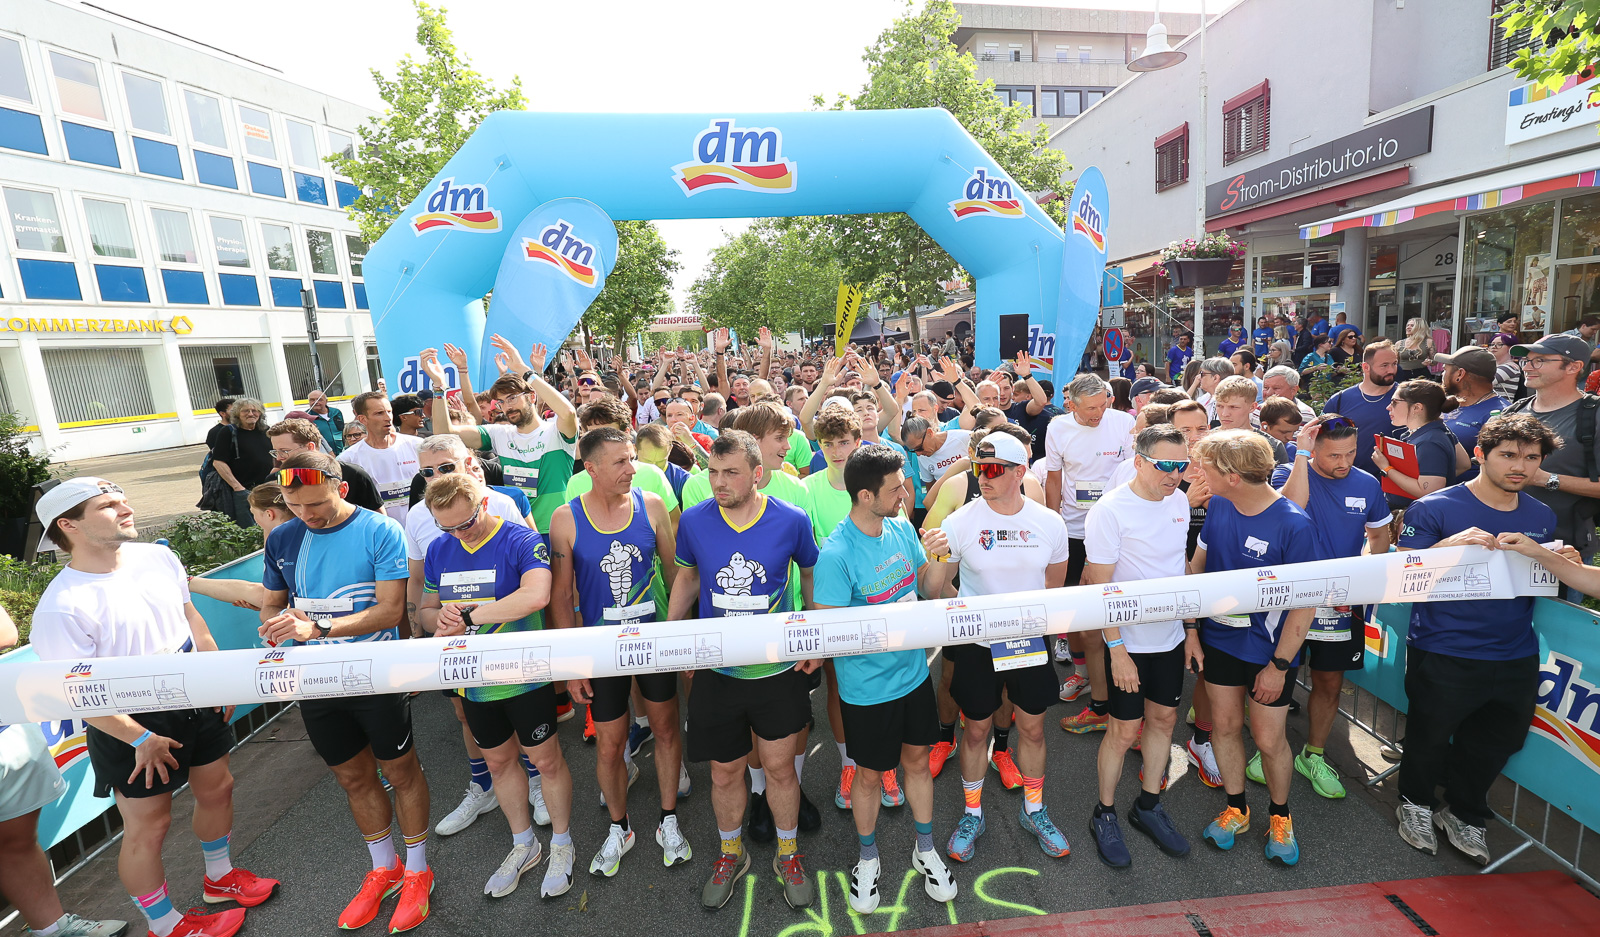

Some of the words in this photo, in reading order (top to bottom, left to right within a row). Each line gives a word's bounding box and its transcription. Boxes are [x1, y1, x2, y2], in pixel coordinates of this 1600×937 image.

[1520, 100, 1583, 129] Ernsting's
[698, 121, 777, 164] dm
[1220, 137, 1399, 211] Strom-Distributor.io
[966, 169, 1012, 200] dm
[427, 180, 484, 213] dm
[14, 213, 56, 224] Kranken-
[1079, 193, 1101, 233] dm
[15, 224, 60, 235] gymnastik
[216, 236, 243, 246] Physio-
[541, 222, 594, 266] dm
[1434, 252, 1458, 266] 28
[1107, 274, 1118, 302] P
[837, 283, 858, 338] SPRINT
[936, 454, 962, 469] BOSCH
[1406, 553, 1421, 563] dm
[1257, 569, 1273, 577] dm
[1405, 571, 1433, 580] FIRMEN
[1435, 575, 1462, 584] HOMBURG
[452, 584, 480, 594] Sascha
[1261, 585, 1290, 596] FIRMEN
[1295, 590, 1323, 599] HOMBURG
[1403, 581, 1430, 593] LAUF
[1108, 599, 1139, 610] FIRMEN
[1145, 605, 1174, 614] HOMBURG
[1260, 595, 1290, 607] LAUF
[788, 613, 805, 621] dm
[950, 613, 982, 624] FIRMEN
[989, 619, 1020, 629] HOMBURG
[1109, 609, 1139, 623] LAUF
[621, 626, 640, 634] dm
[788, 628, 820, 639] FIRMEN
[827, 633, 859, 643] HOMBURG
[952, 624, 983, 638] LAUF
[448, 638, 467, 646] dm
[619, 641, 653, 652] FIRMEN
[659, 647, 692, 657] HOMBURG
[789, 638, 821, 653] LAUF
[1005, 639, 1031, 650] Martin
[264, 650, 286, 659] dm
[619, 652, 653, 667] LAUF
[71, 662, 93, 673] dm
[443, 655, 478, 666] FIRMEN
[485, 661, 519, 671] HOMBURG
[259, 669, 296, 681] FIRMEN
[303, 676, 339, 685] HOMBURG
[443, 666, 477, 681] LAUF
[69, 683, 106, 694] FIRMEN
[116, 690, 152, 699] HOMBURG
[260, 681, 296, 695] LAUF
[72, 694, 109, 707] LAUF
